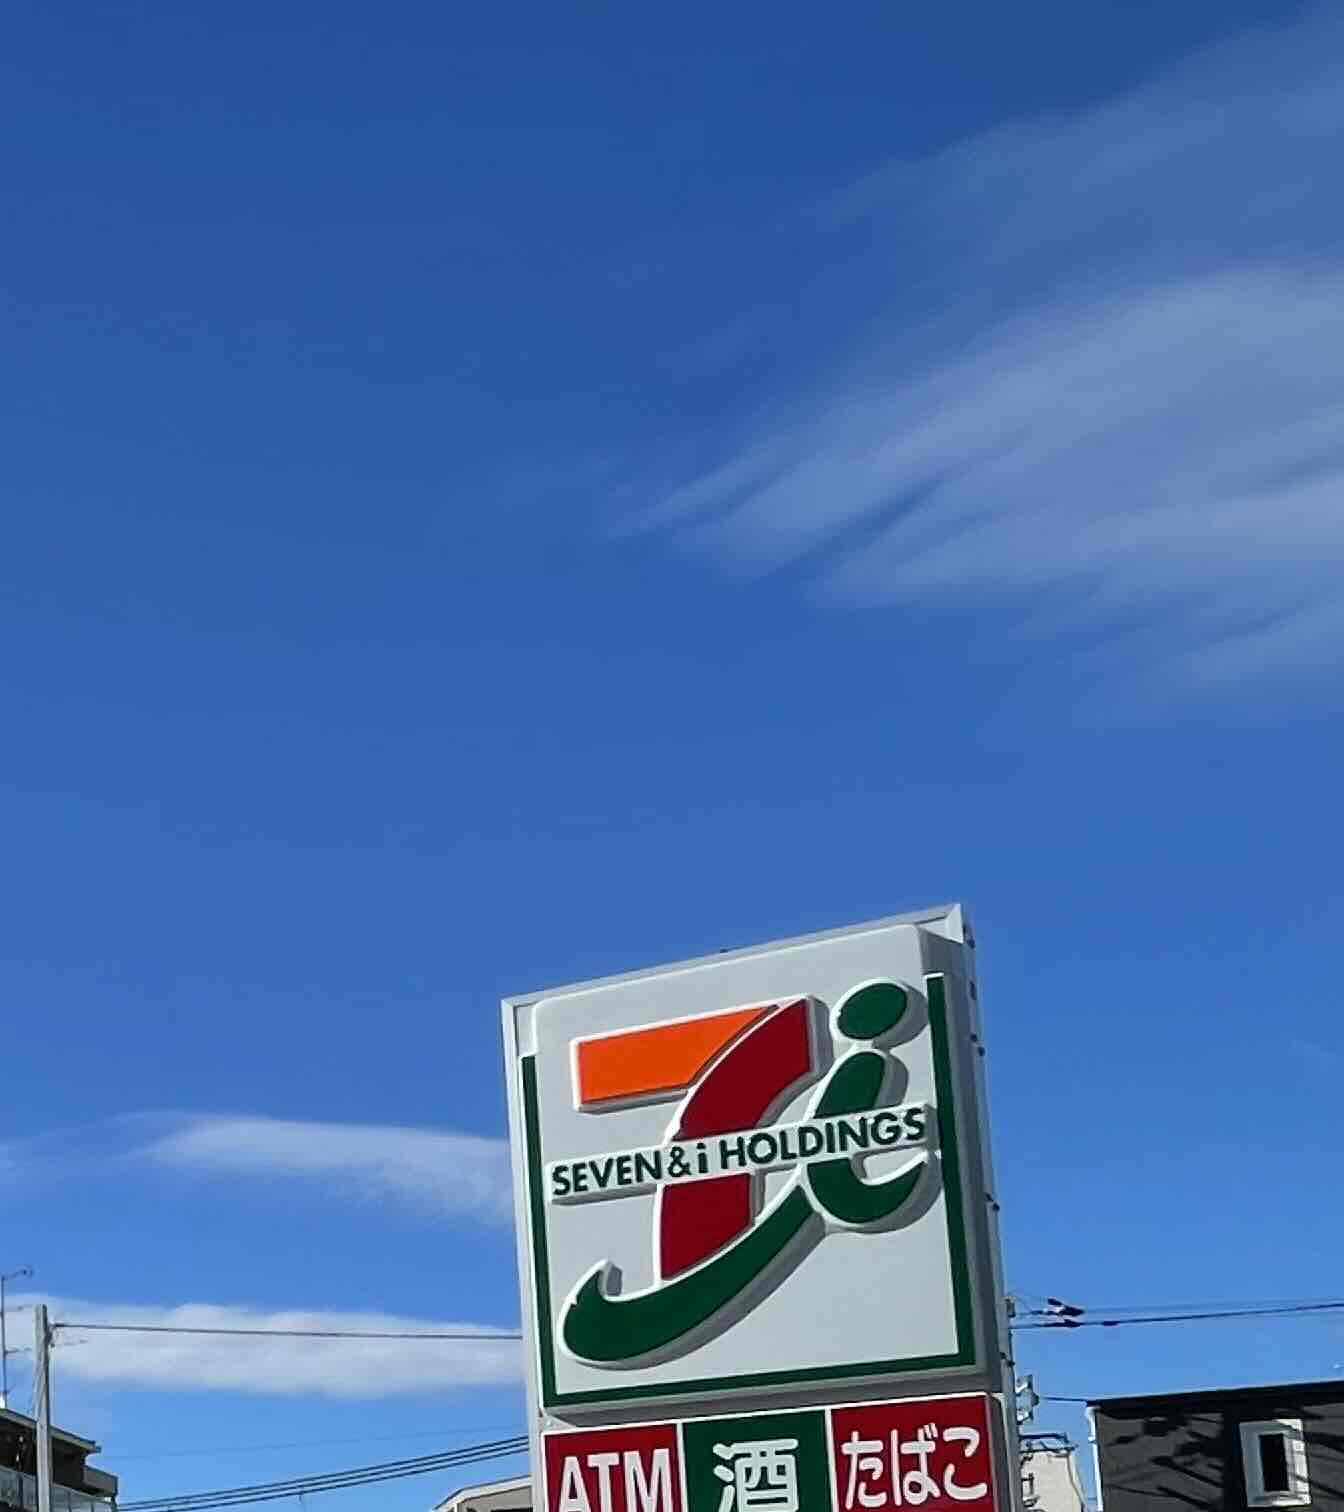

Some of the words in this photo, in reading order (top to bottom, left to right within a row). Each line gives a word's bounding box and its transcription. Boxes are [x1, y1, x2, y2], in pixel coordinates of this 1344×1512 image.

[719, 1106, 927, 1167] HOLDINGS
[841, 1423, 988, 1511] たばこ
